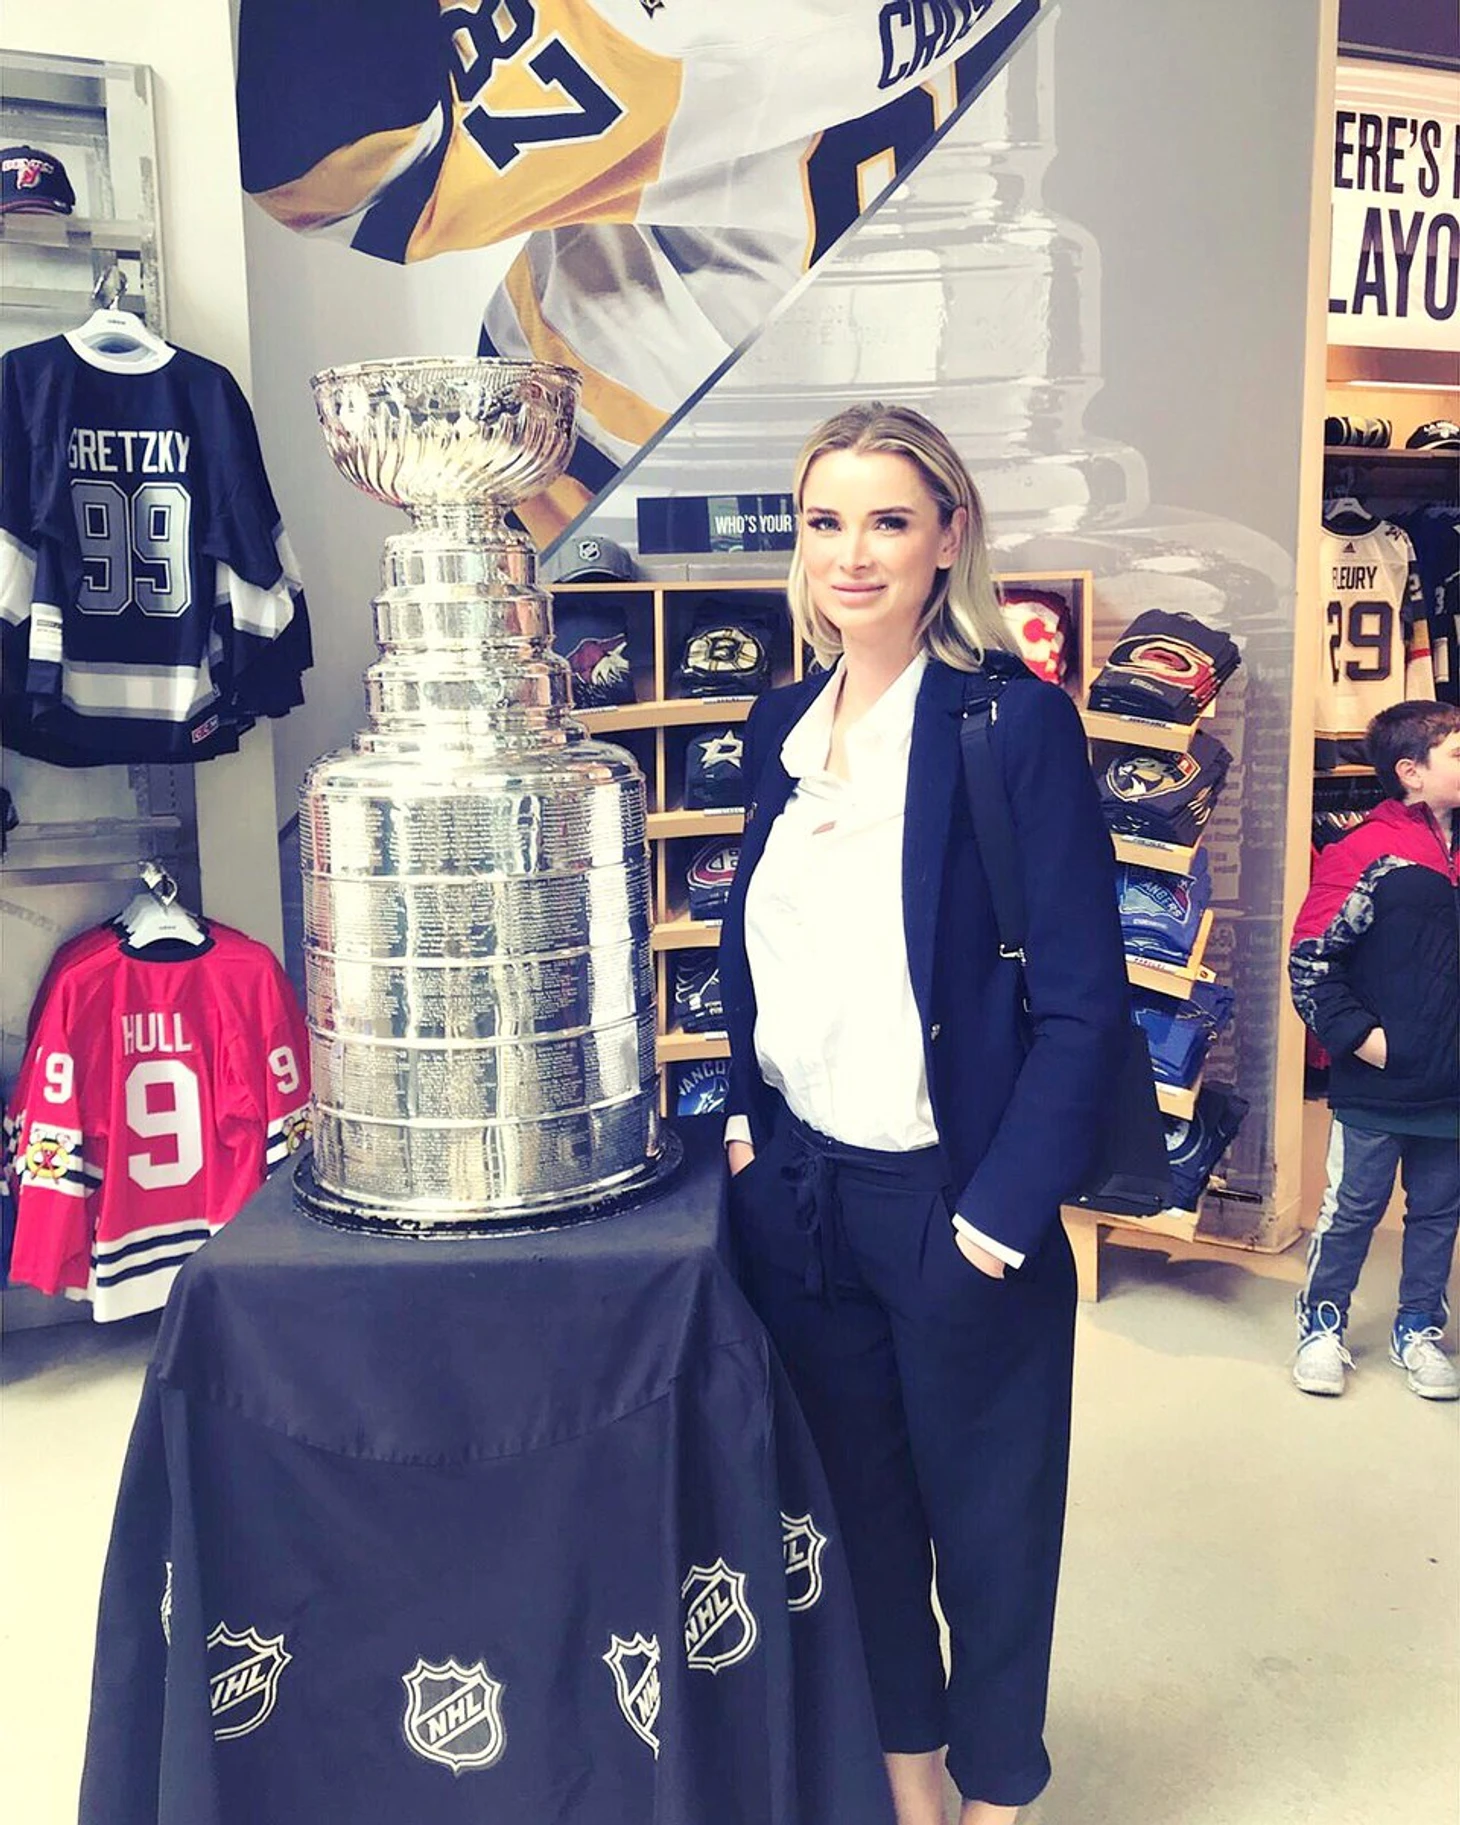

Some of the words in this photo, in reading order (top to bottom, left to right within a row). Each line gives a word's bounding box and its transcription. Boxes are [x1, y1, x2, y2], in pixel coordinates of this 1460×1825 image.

[68, 427, 190, 473] GRETZKY
[70, 478, 192, 618] 99
[714, 514, 757, 534] WHO'S
[759, 514, 793, 534] YOUR
[1140, 882, 1182, 917] ANGERS
[122, 1012, 192, 1056] HULL
[43, 1052, 74, 1105] 9
[267, 1046, 299, 1095] 9
[125, 1059, 204, 1191] 9
[685, 1589, 729, 1652] NHL
[426, 1691, 482, 1744] NHL
[636, 1667, 660, 1725] NH
